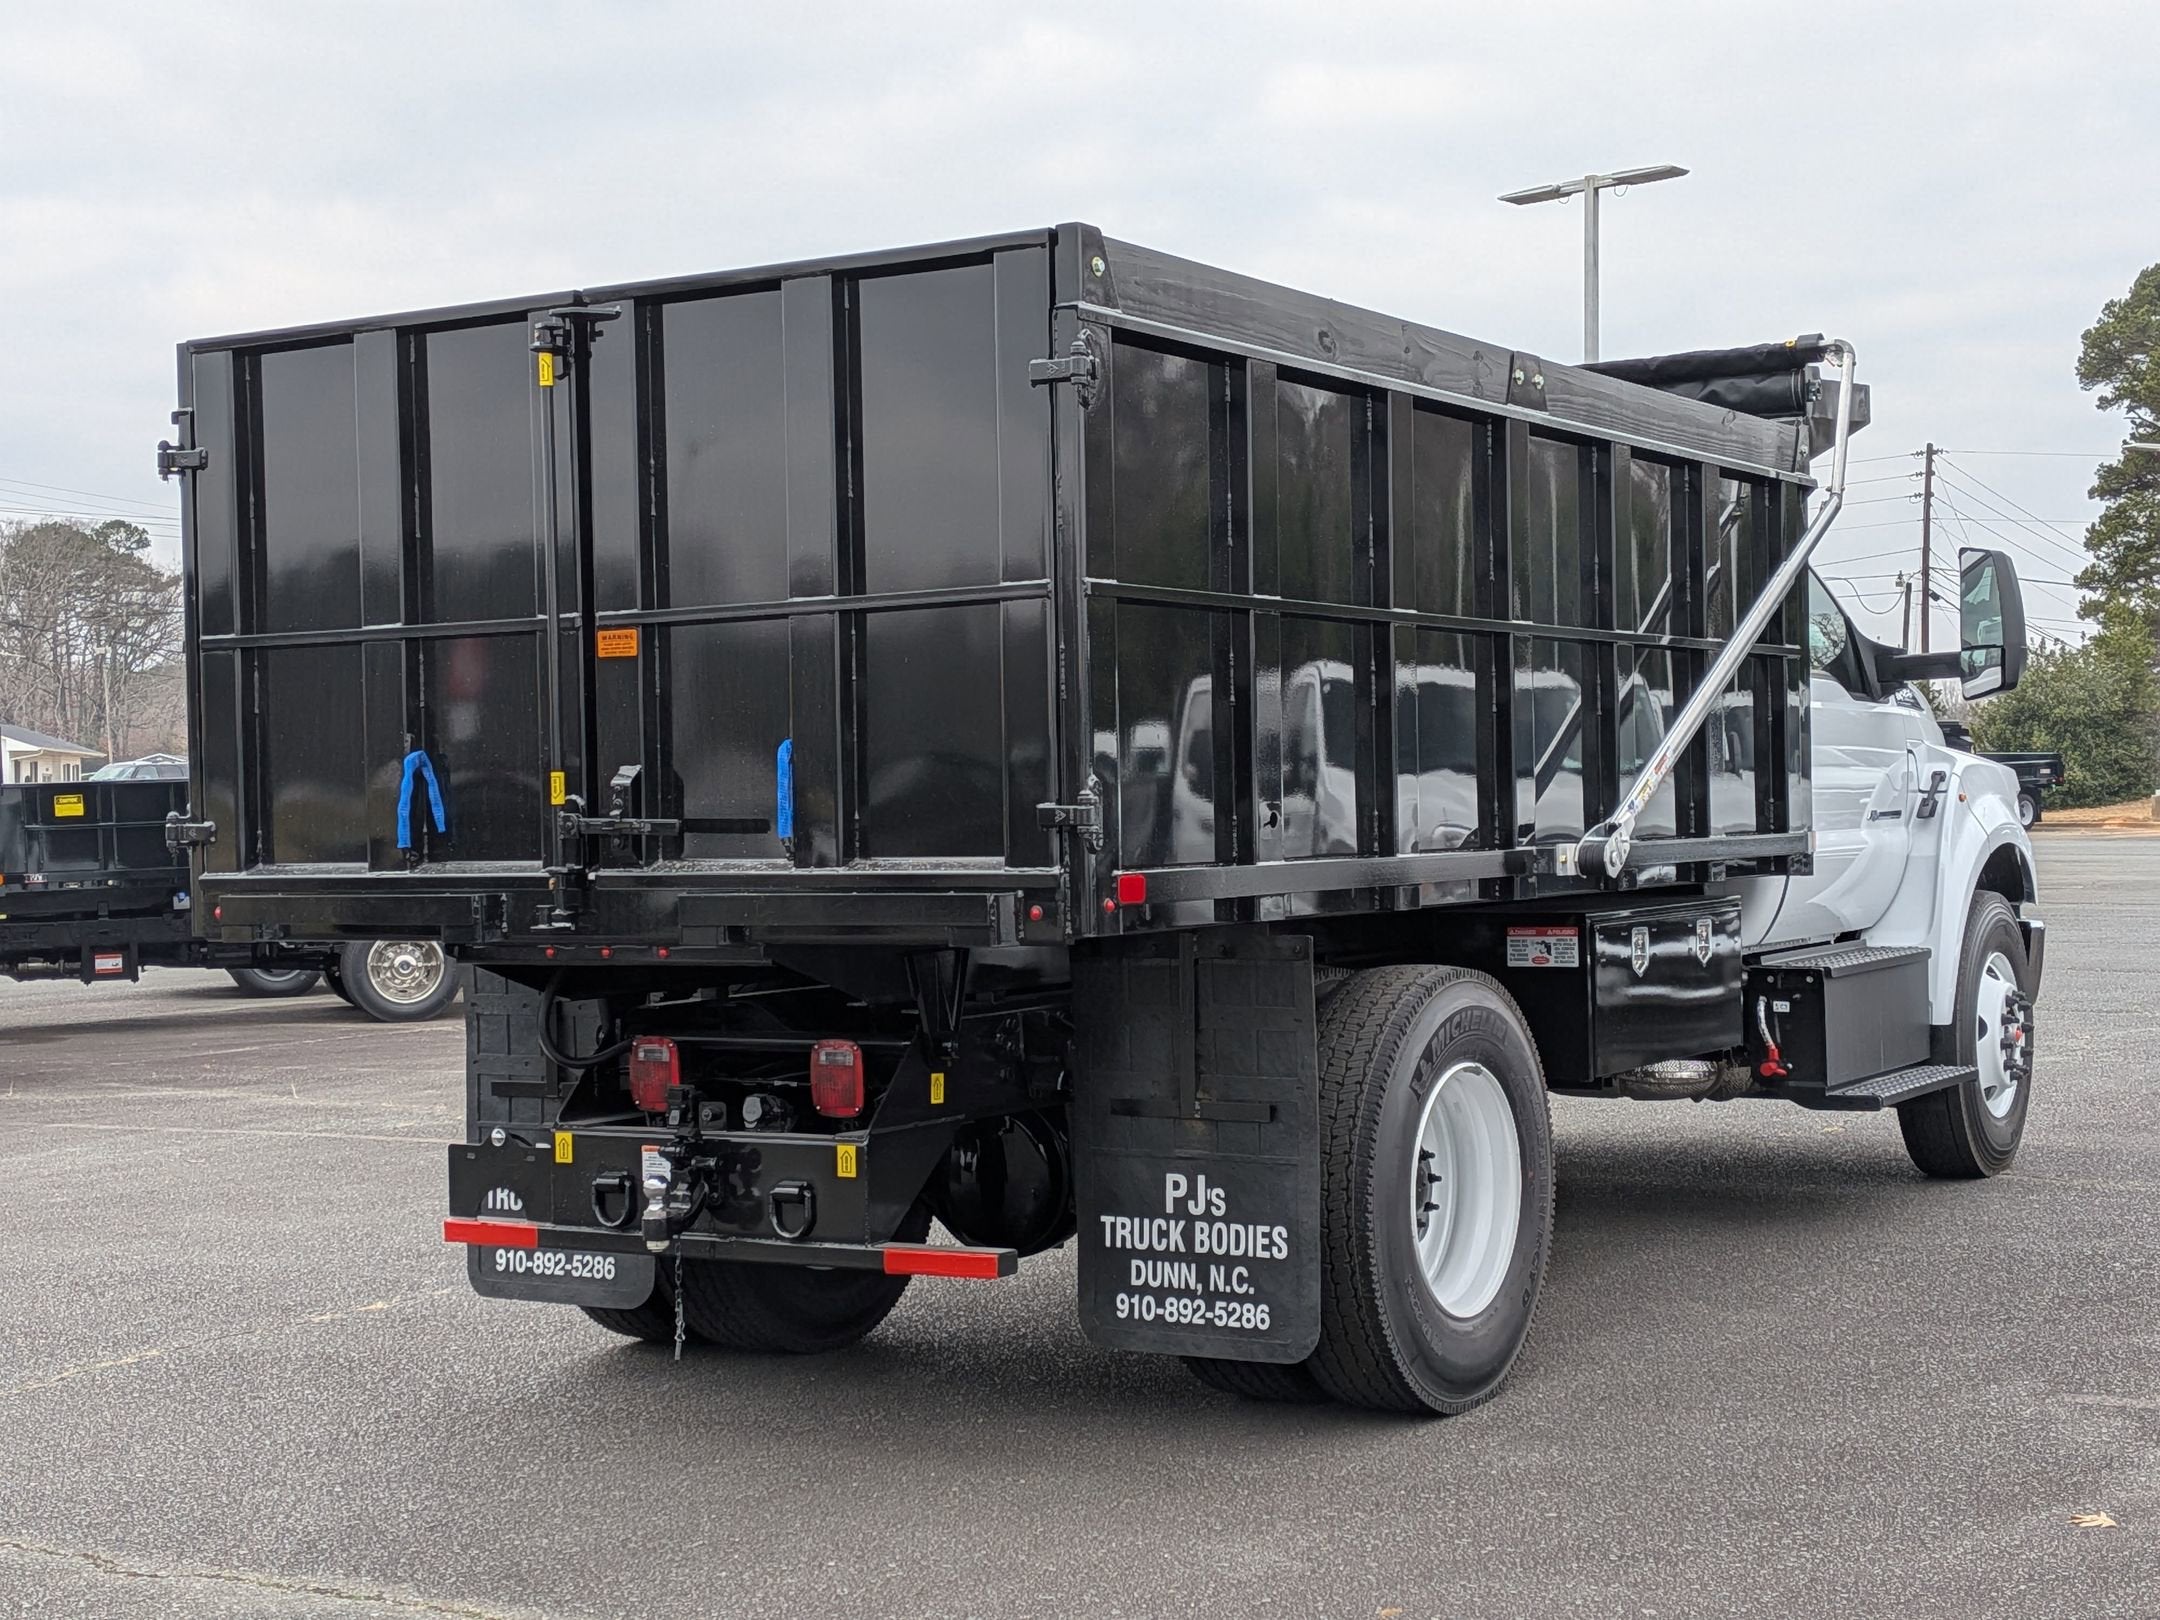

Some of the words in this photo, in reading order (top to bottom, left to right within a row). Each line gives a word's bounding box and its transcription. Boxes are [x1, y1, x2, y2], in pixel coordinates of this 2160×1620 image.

[1431, 1009, 1508, 1060] MICHELIN
[1165, 1173, 1227, 1217] PJ's
[1100, 1215, 1186, 1253] TRUCK
[1194, 1221, 1288, 1260] BODIES
[495, 1248, 616, 1280] 910-892-5286
[1130, 1259, 1203, 1296] DUNN,
[1209, 1264, 1255, 1295] N.C.
[1116, 1292, 1271, 1331] 910-892-5286
